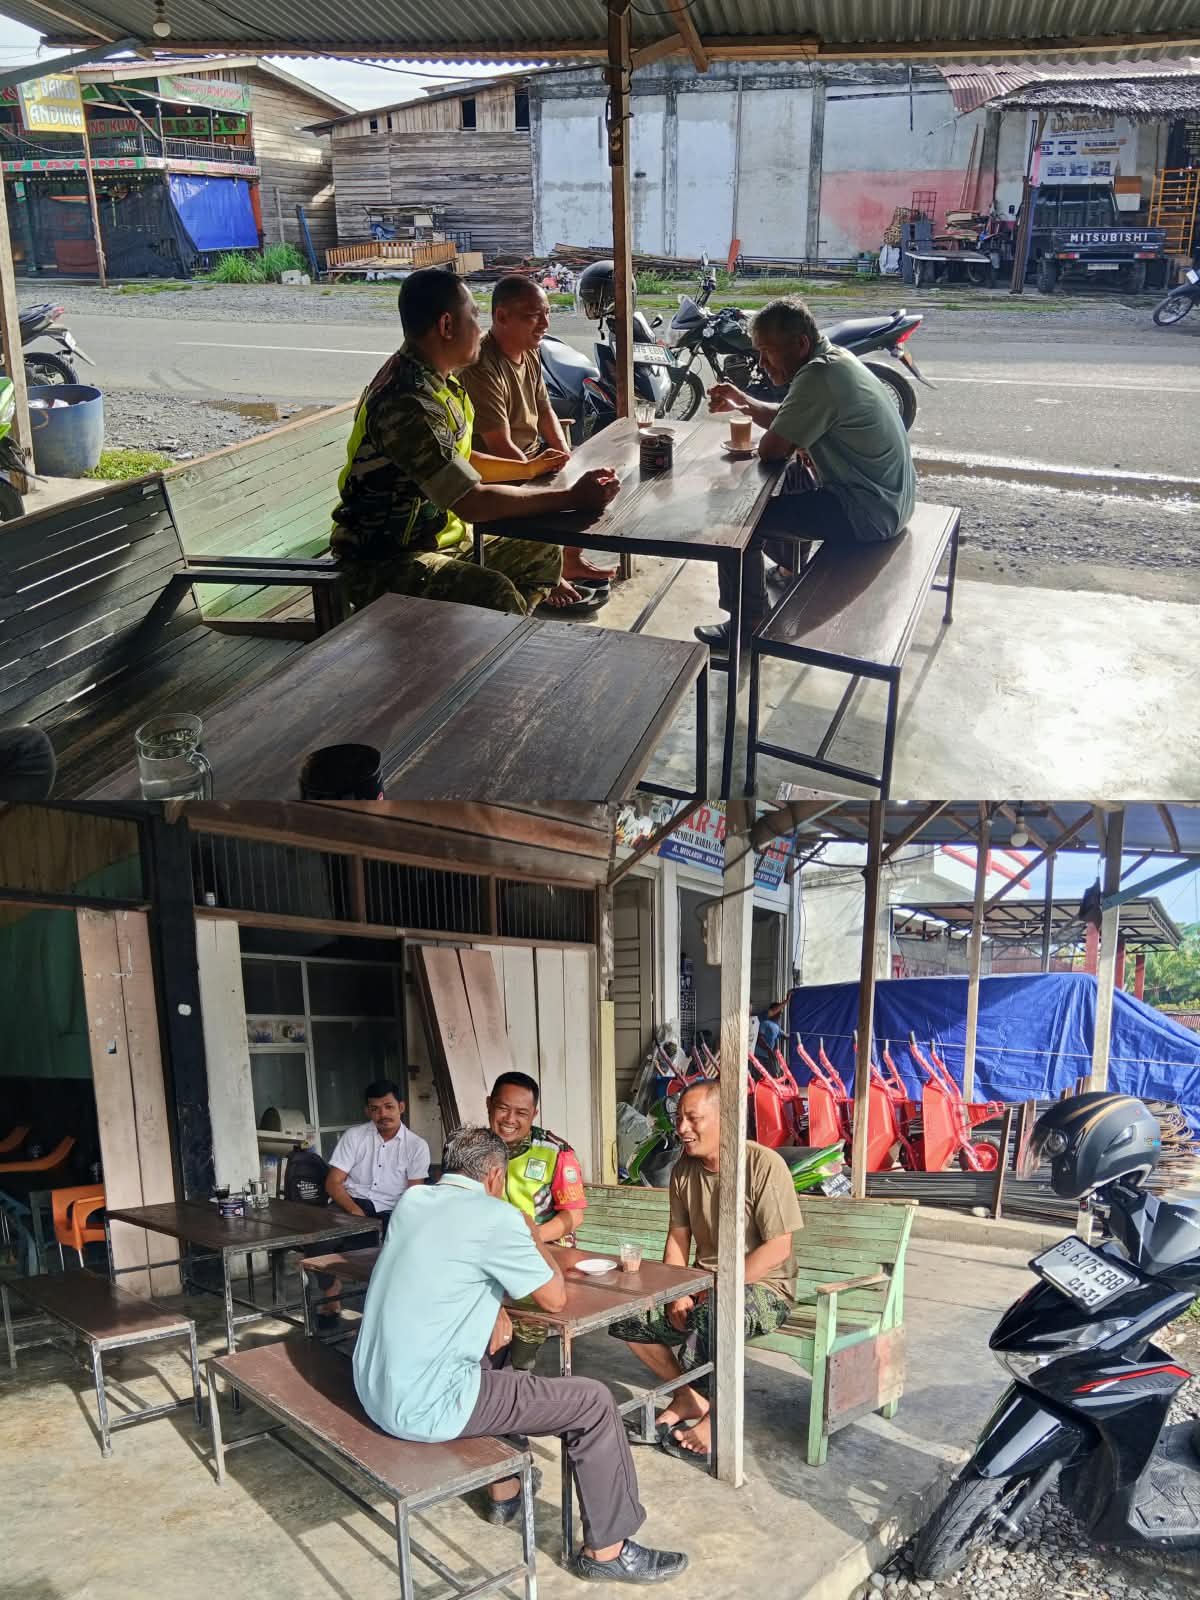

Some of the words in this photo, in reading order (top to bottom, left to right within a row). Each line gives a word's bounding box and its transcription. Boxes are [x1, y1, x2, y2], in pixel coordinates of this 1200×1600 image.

[40, 79, 77, 99] BAKSO
[29, 104, 82, 128] ANDIKA
[1070, 232, 1149, 242] MITSUBISHI
[1055, 1241, 1075, 1257] BL
[1070, 1252, 1103, 1275] 6175
[1095, 1269, 1126, 1291] EBB
